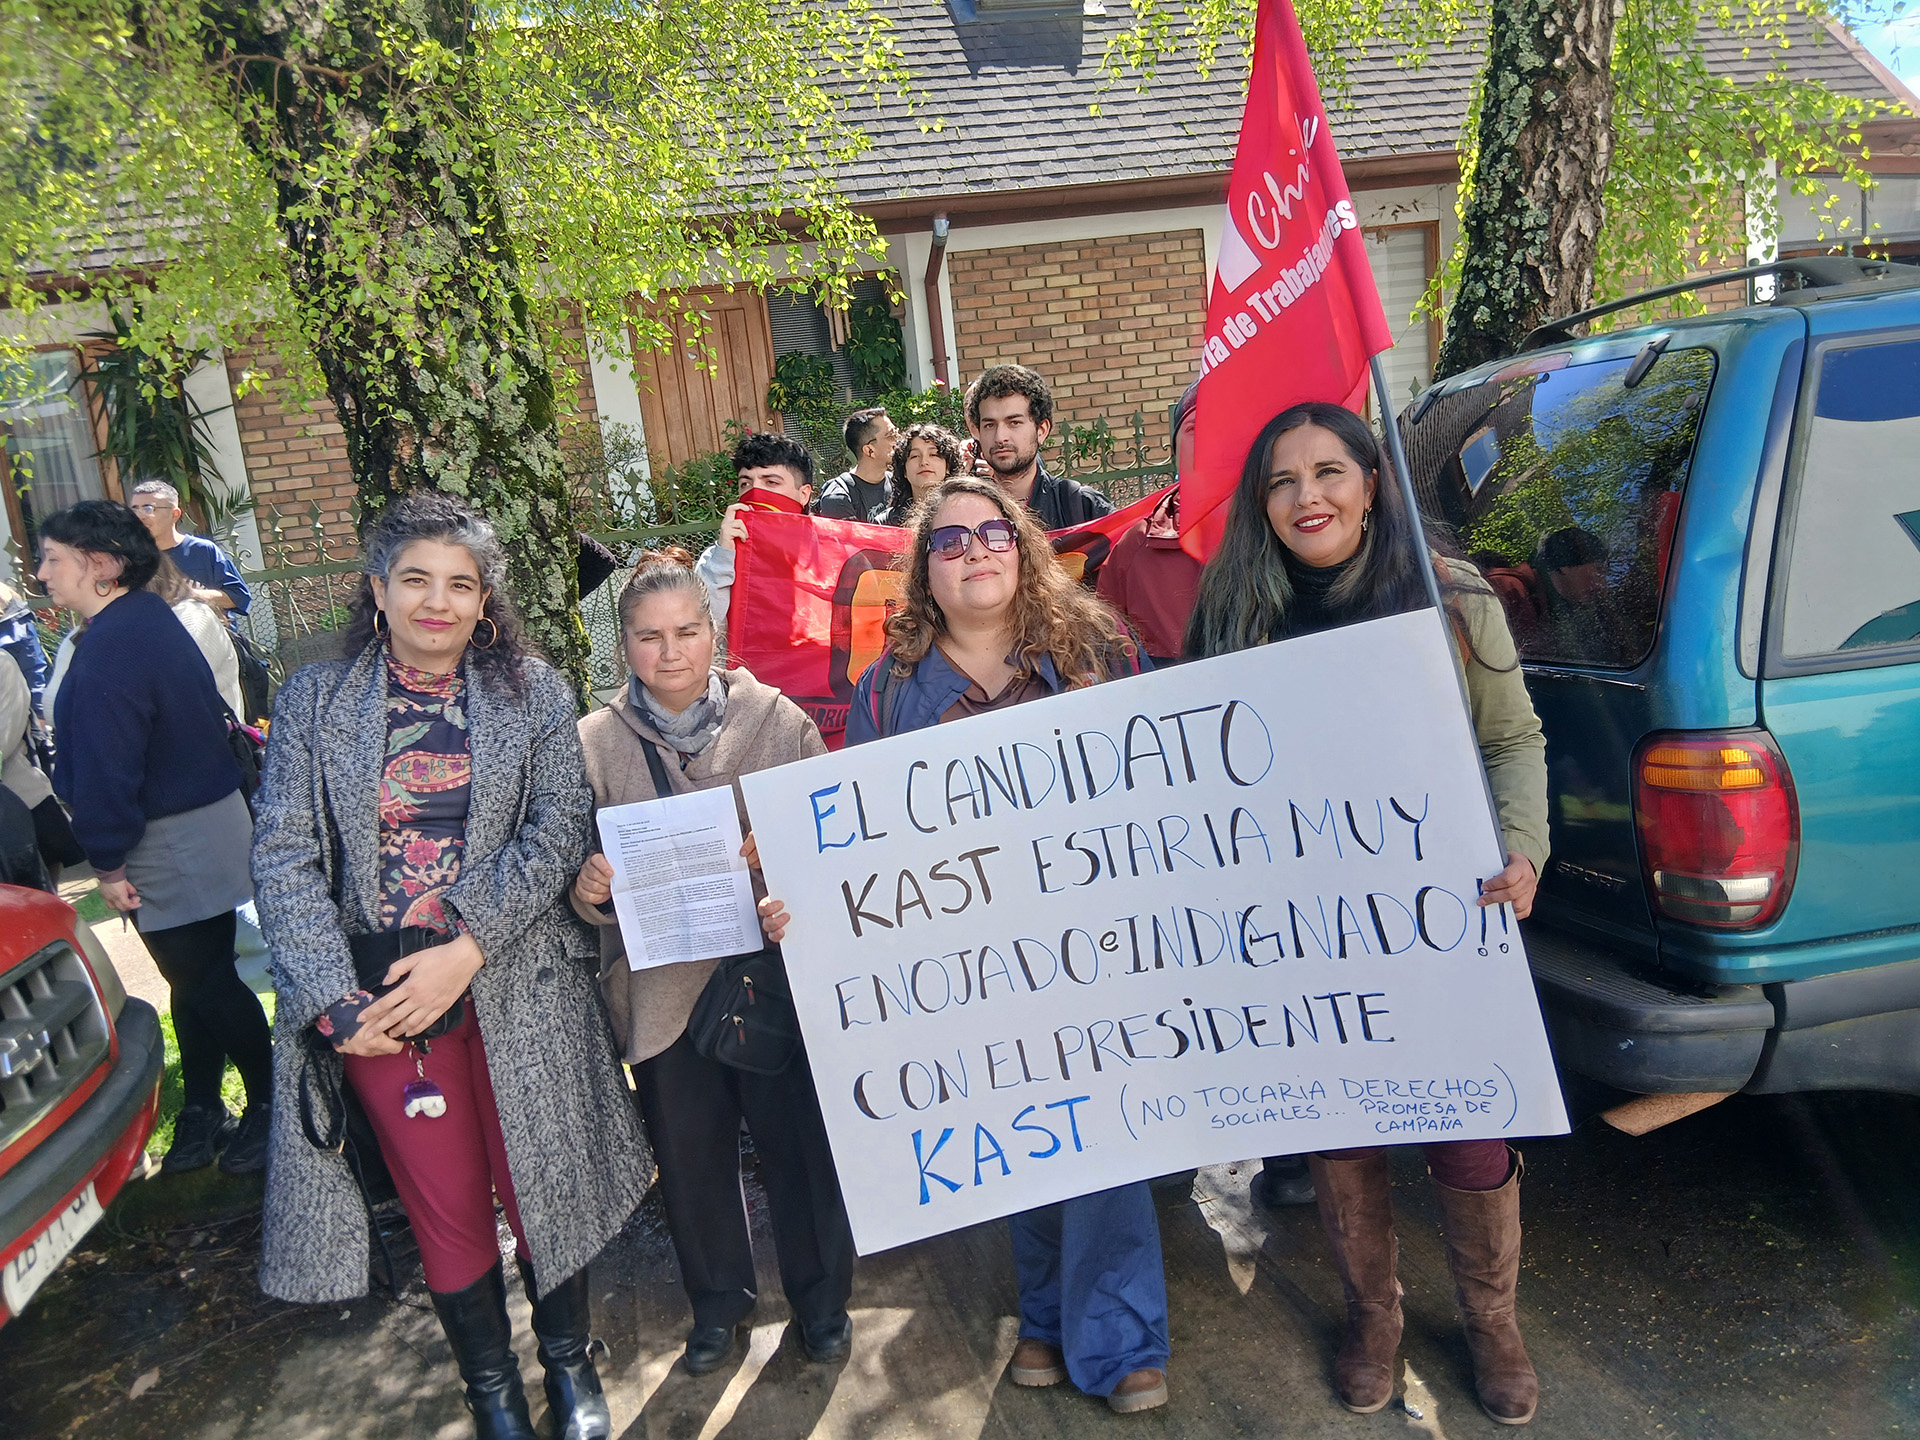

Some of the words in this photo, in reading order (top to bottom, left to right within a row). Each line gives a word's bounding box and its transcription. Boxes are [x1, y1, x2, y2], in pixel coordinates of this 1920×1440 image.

[1247, 112, 1319, 250] Chile
[1222, 311, 1258, 350] de
[808, 780, 889, 854] EL
[840, 845, 1001, 938] KAST
[1032, 806, 1271, 894] ESTARIA
[1288, 792, 1429, 862] MUY
[853, 1048, 969, 1120] CON
[985, 1038, 1050, 1090] EL
[1359, 1097, 1458, 1115] PROMESA
[1464, 1099, 1493, 1115] DE
[1374, 1115, 1464, 1135] CAMPAÑA
